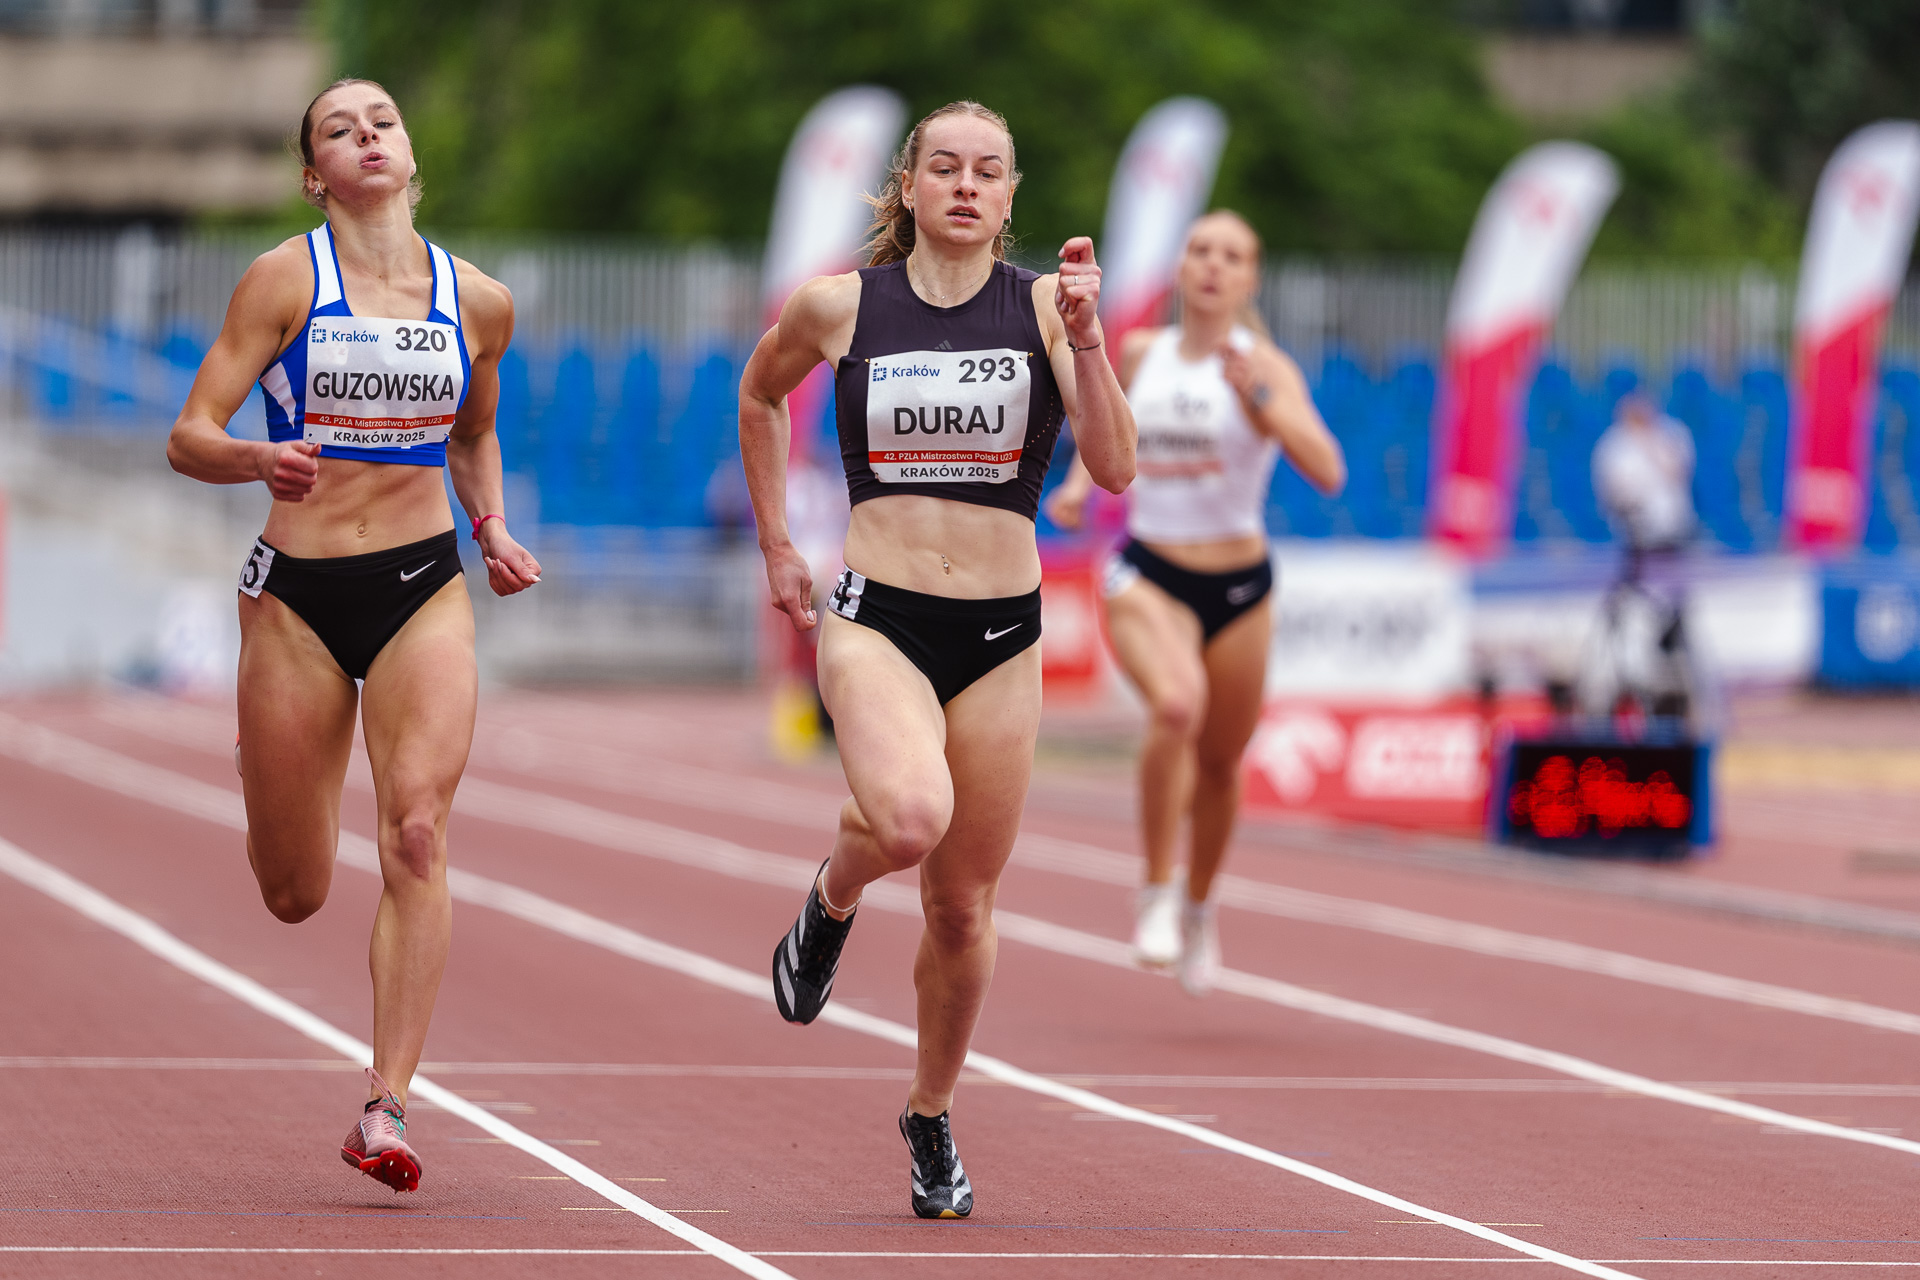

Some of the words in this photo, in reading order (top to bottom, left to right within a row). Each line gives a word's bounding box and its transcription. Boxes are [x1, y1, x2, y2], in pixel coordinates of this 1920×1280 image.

[332, 330, 379, 343] Kraków
[395, 327, 447, 352] 320
[892, 364, 941, 378] Kraków
[958, 357, 1016, 383] 293
[313, 371, 454, 402] GUZOWSKA
[319, 416, 332, 424] 42.
[333, 418, 353, 426] PZLA
[355, 419, 403, 428] Mistrzostwa
[405, 418, 427, 427] Polski
[428, 416, 443, 424] U23
[894, 405, 1005, 435] DURAJ
[333, 431, 394, 444] KRAKÓW
[396, 431, 426, 443] 2025
[920, 452, 973, 460] Mistrzostwa
[975, 453, 999, 462] Polski
[1000, 453, 1013, 462] U23
[900, 464, 965, 478] KRAKÓW
[967, 466, 1000, 478] 2025
[243, 545, 265, 589] 5
[834, 570, 852, 612] 4
